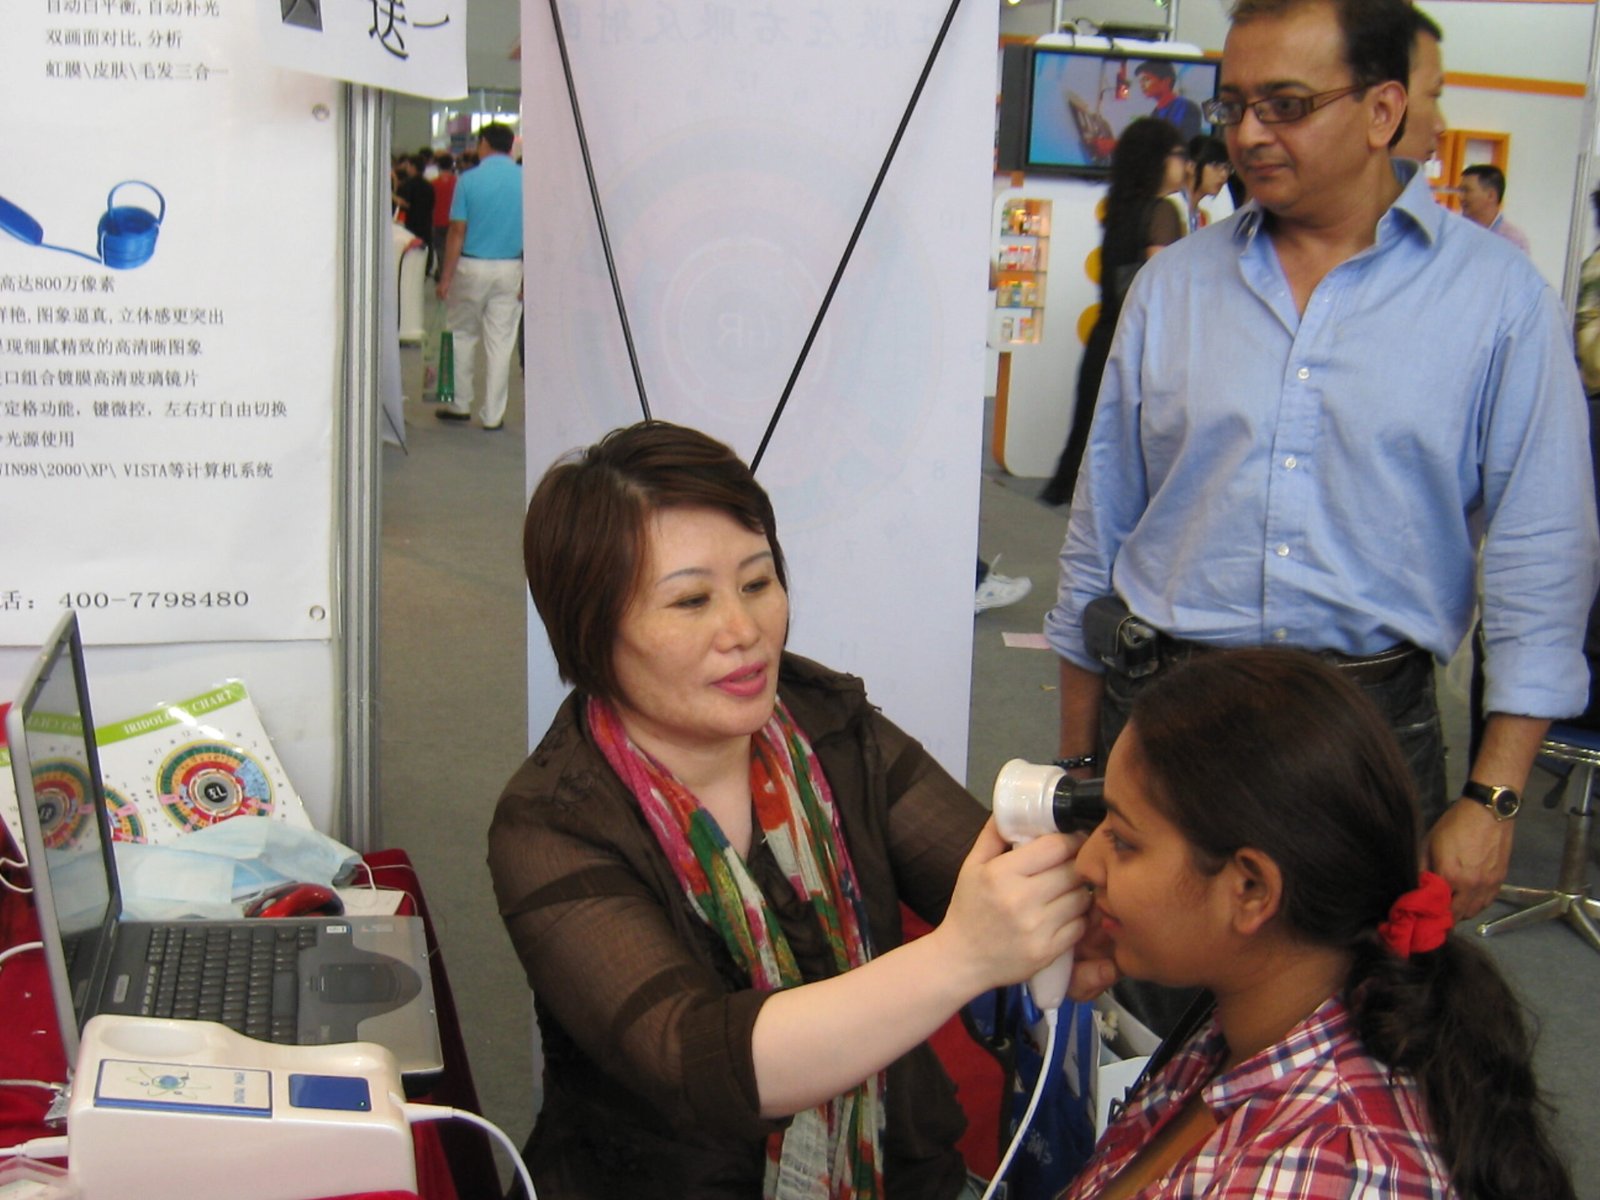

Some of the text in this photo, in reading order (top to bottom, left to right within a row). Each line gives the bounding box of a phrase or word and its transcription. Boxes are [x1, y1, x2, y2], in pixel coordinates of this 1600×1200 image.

[0, 337, 203, 356] 现细腻精致的高清晰图象
[0, 369, 198, 388] 口组合镀膜高清玻璃镜片
[0, 430, 75, 448] 光源使用
[58, 590, 249, 609] 400-7798480
